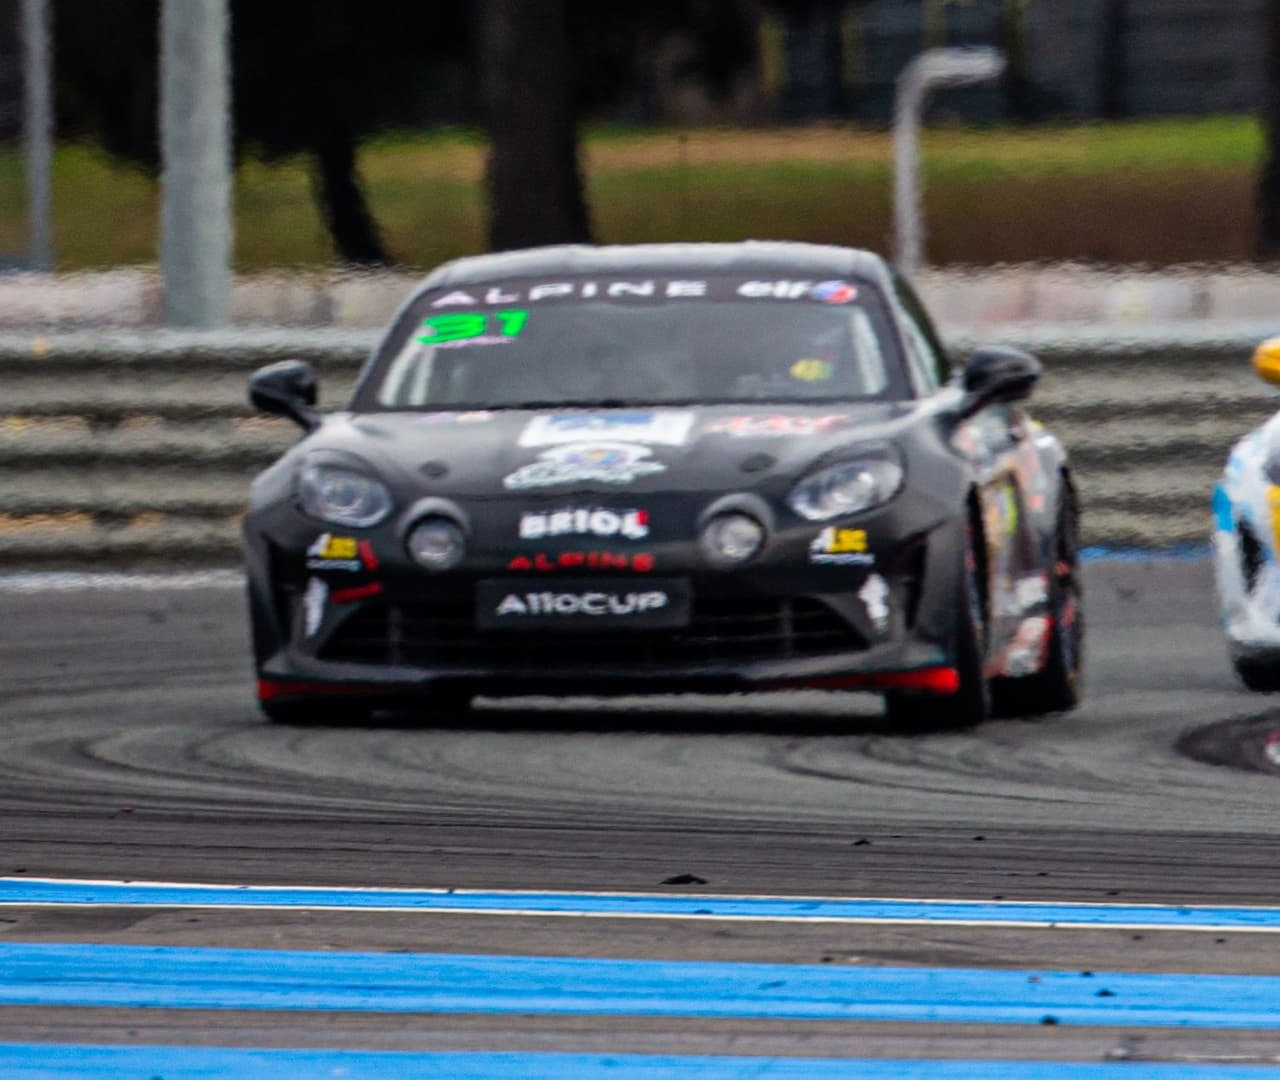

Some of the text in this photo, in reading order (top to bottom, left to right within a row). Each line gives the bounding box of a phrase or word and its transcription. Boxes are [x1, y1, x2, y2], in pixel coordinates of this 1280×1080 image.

[431, 279, 813, 307] ALPINE elf
[507, 550, 656, 572] ALPINE
[497, 589, 668, 616] A110CUP
